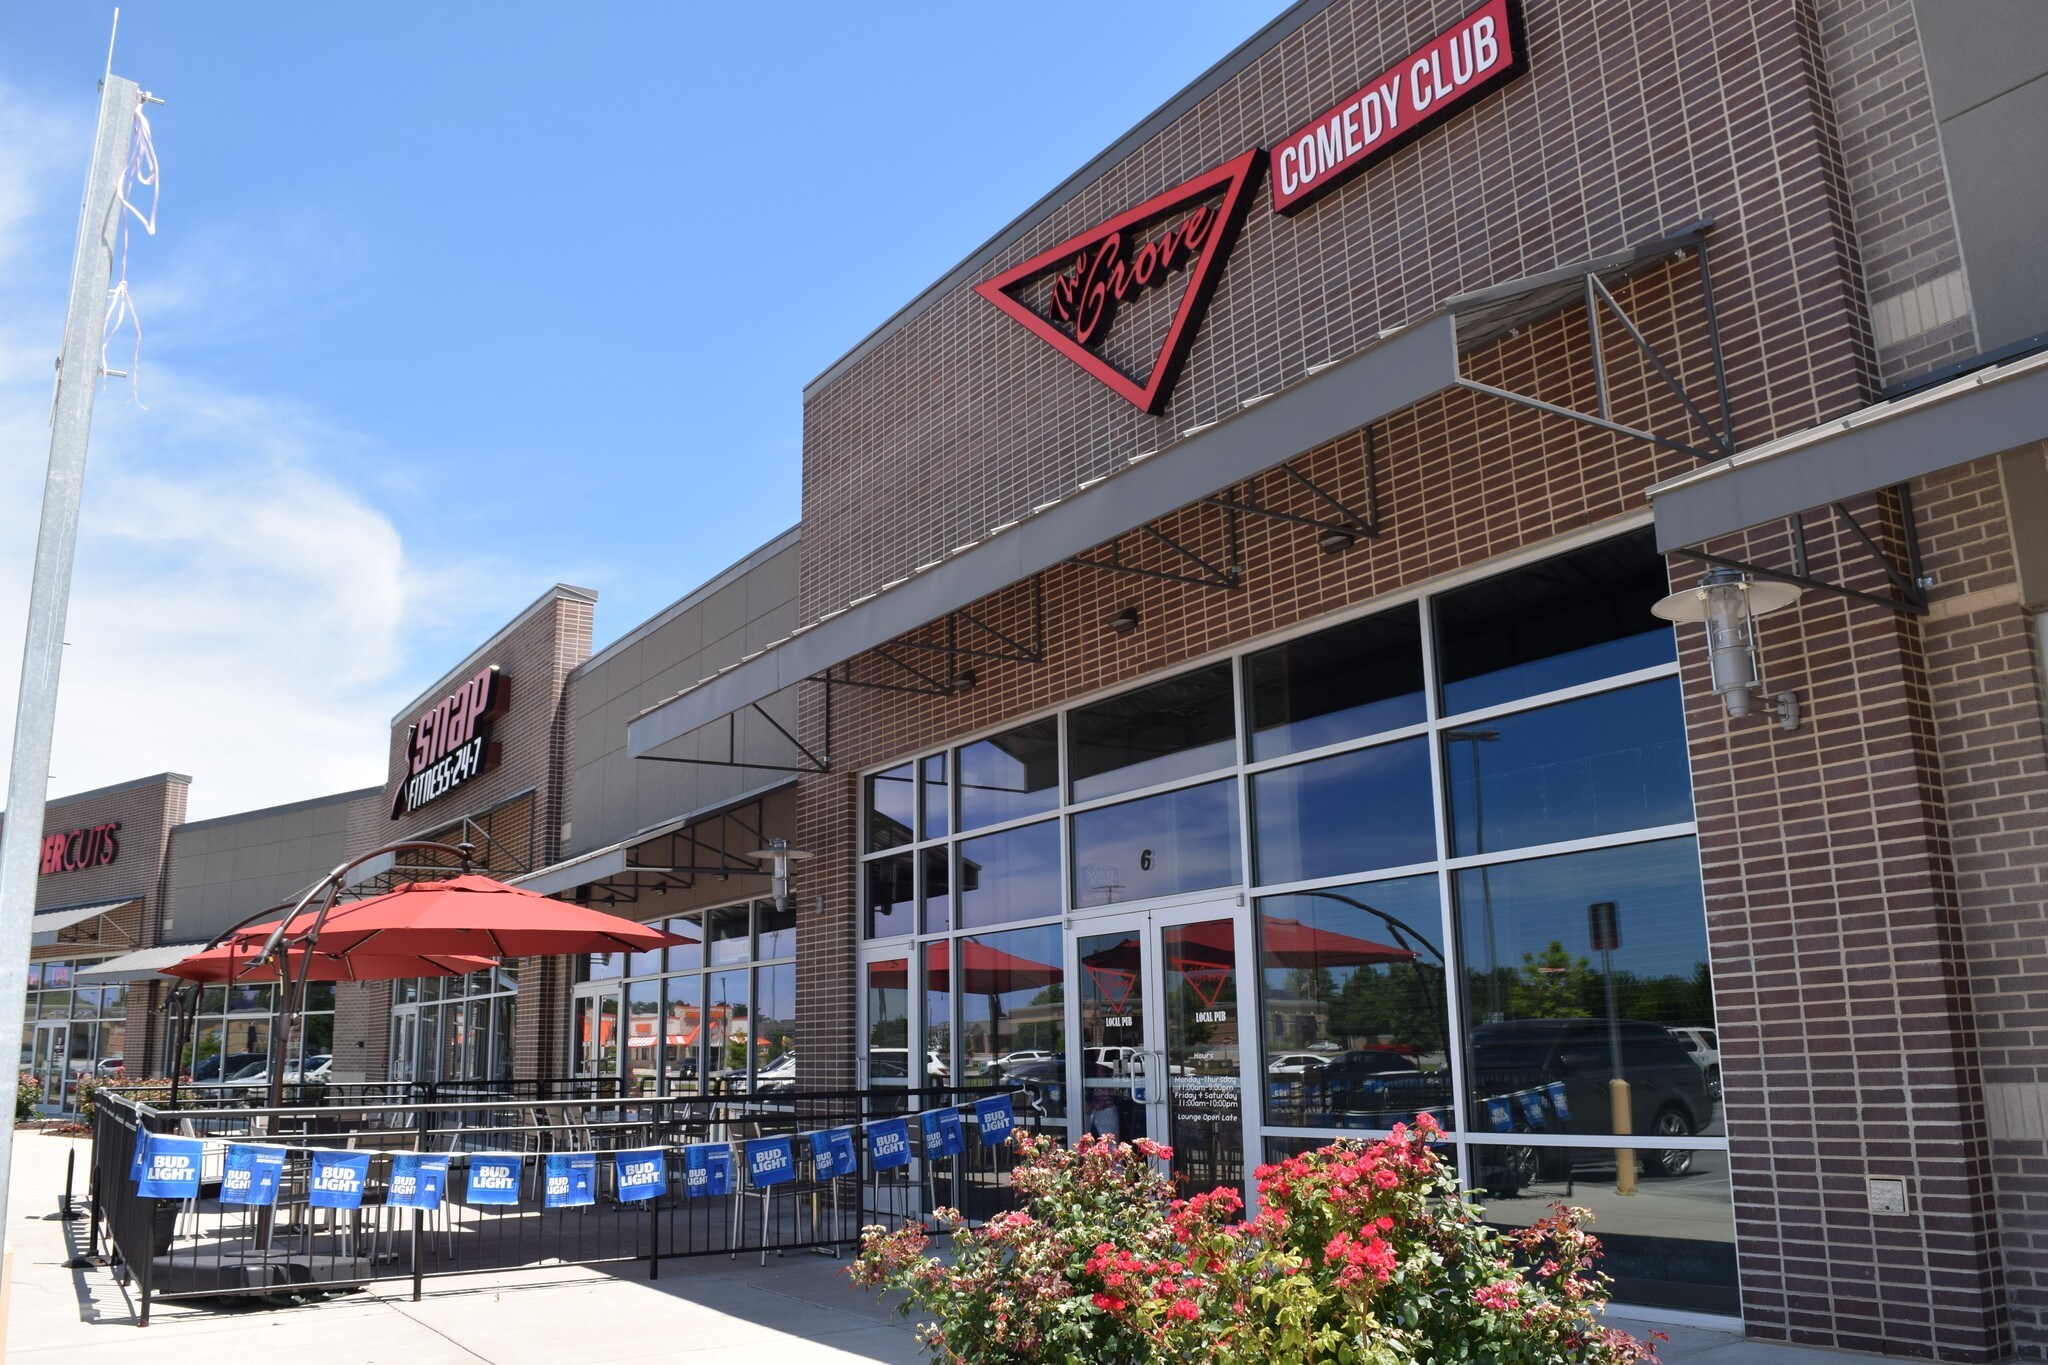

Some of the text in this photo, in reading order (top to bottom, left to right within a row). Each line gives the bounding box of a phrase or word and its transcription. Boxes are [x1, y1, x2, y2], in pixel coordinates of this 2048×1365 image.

[1279, 15, 1498, 195] COMEDY CLUB
[1049, 206, 1215, 344] The Grove
[1140, 849, 1152, 871] 6
[1106, 1016, 1133, 1027] LOCAL PUB
[1195, 1011, 1227, 1022] LOCAL PUB
[1174, 1075, 1237, 1084] Monday-Thursday
[1174, 1091, 1197, 1100] Friday
[1204, 1091, 1238, 1101] Saturday
[984, 1110, 1005, 1123] BUD
[1177, 1113, 1238, 1122] Lounge Open Late
[981, 1118, 1010, 1133] LIGHT
[876, 1133, 899, 1147] BUD
[926, 1131, 941, 1142] BUD
[755, 1148, 782, 1163] BUD
[873, 1140, 905, 1158] LIGHT
[154, 1155, 190, 1168] BUD
[816, 1151, 832, 1163] BUD
[479, 1166, 510, 1177] BUD
[625, 1162, 655, 1175] BUD
[752, 1157, 788, 1174] LIGHT
[147, 1168, 195, 1180] LIGHT
[227, 1169, 251, 1180] BUD
[321, 1166, 356, 1179] BUD
[620, 1171, 661, 1187] LIGHT
[688, 1168, 707, 1177] BUD
[313, 1177, 361, 1192] LIGHT
[394, 1176, 416, 1185] BUD
[472, 1176, 514, 1189] LIGHT
[548, 1176, 568, 1186] BUD
